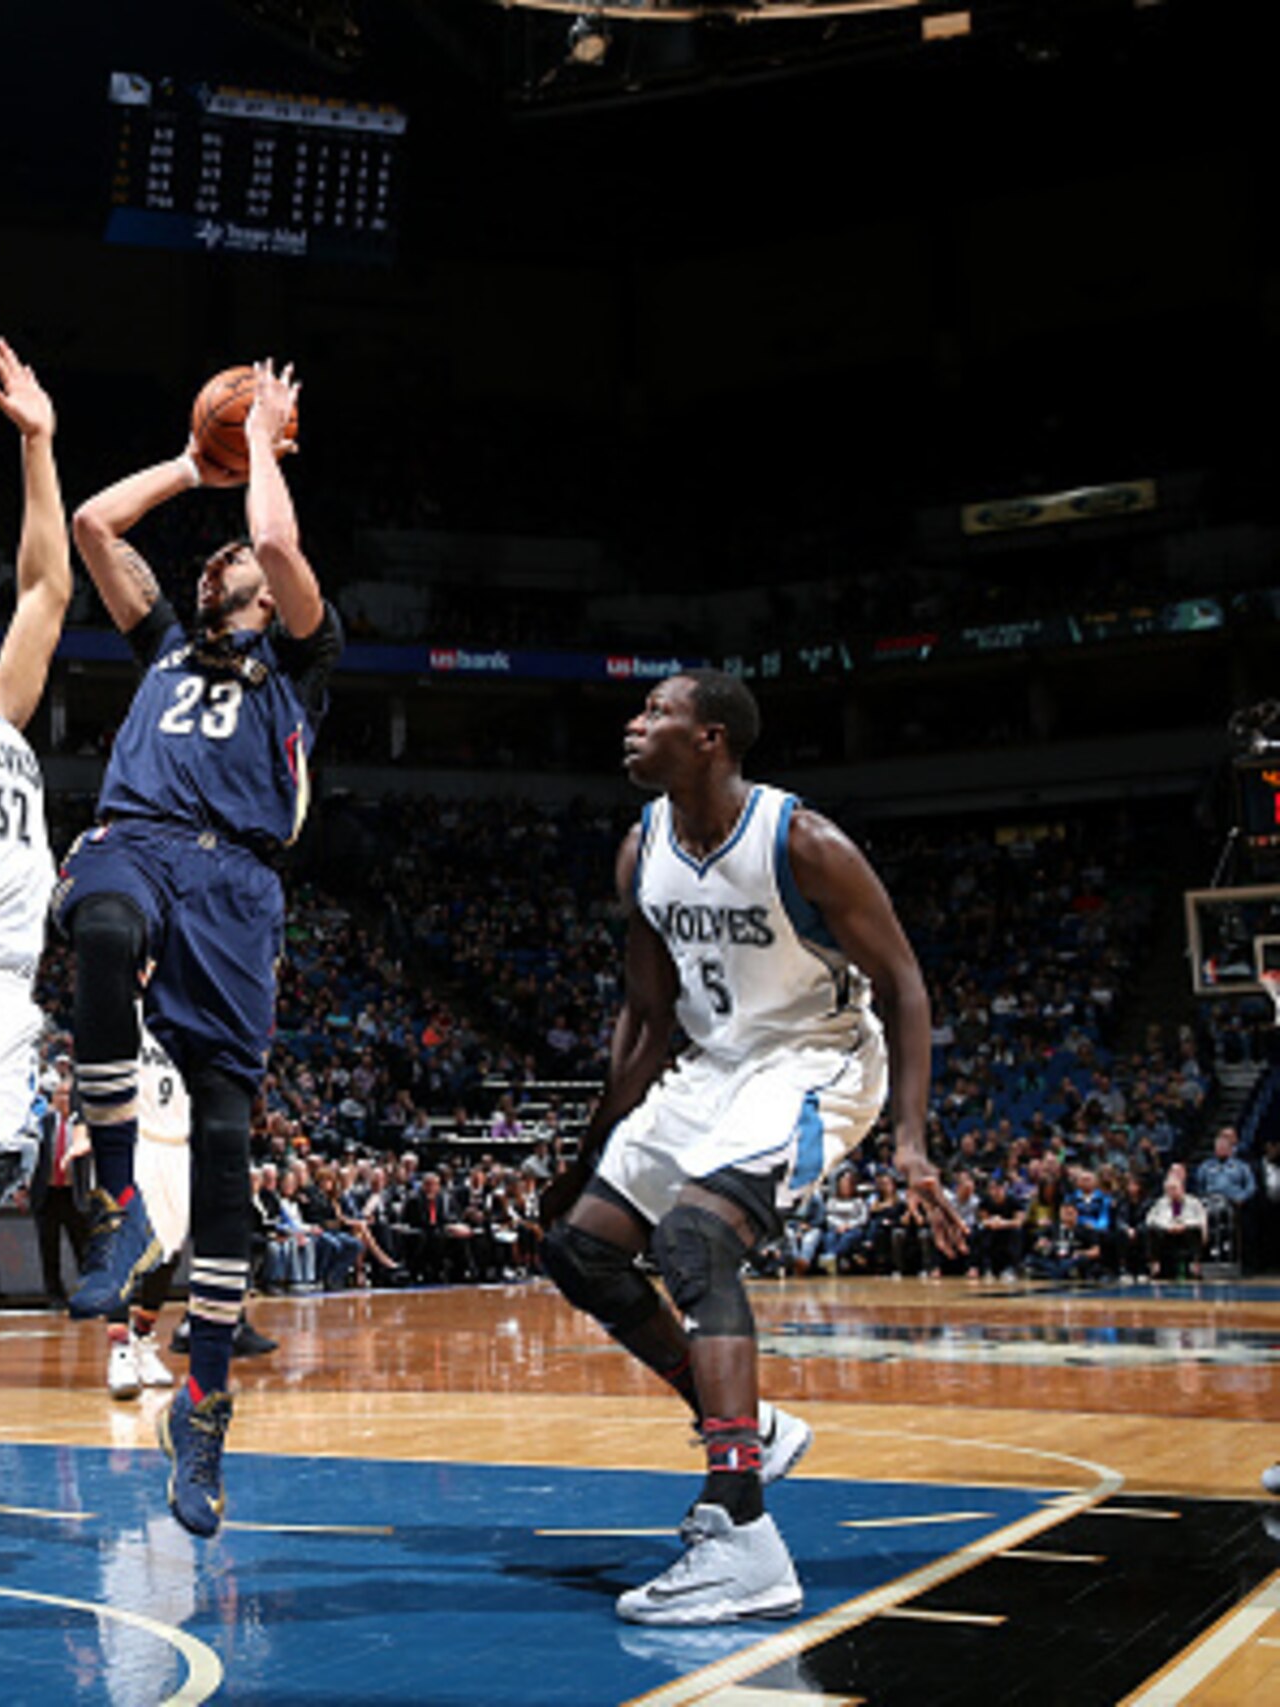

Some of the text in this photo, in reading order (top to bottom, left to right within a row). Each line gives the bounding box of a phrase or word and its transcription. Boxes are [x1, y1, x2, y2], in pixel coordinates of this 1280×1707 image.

[158, 675, 243, 739] 23
[649, 901, 775, 948] WOLVES
[701, 960, 732, 1015] 5
[159, 1076, 173, 1105] 9
